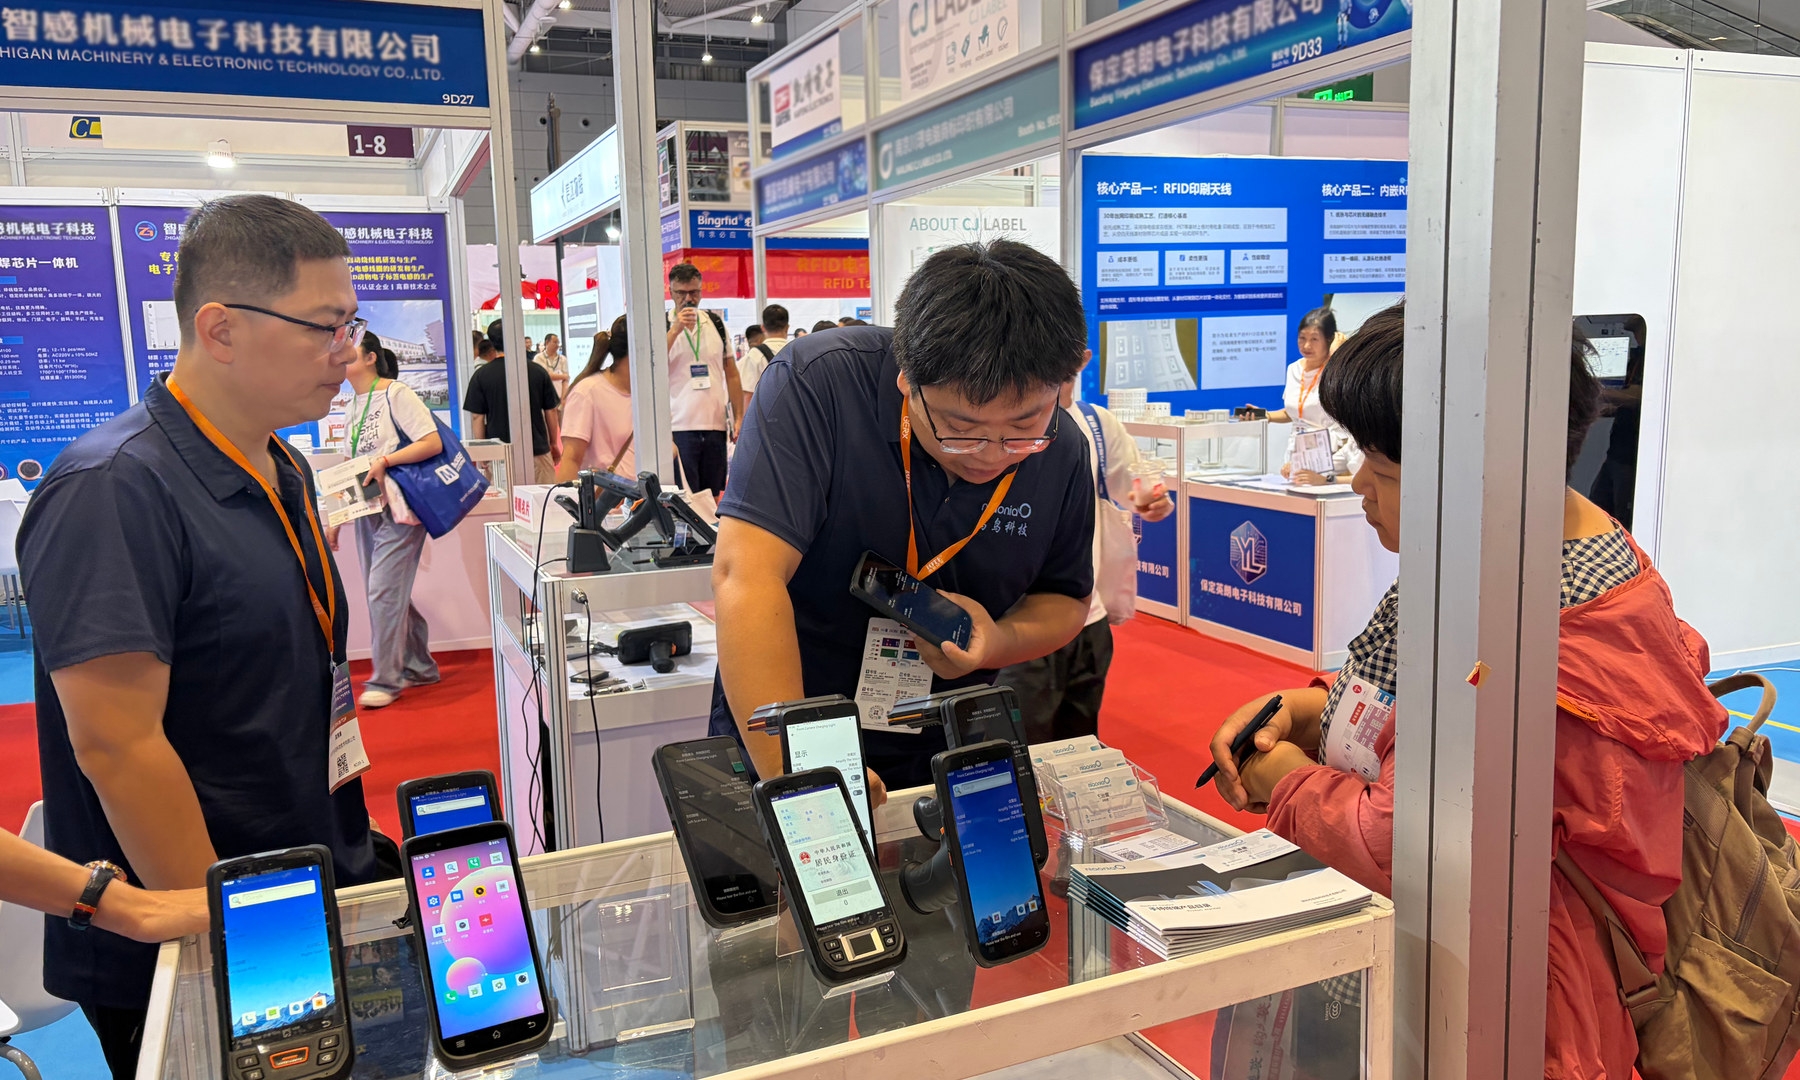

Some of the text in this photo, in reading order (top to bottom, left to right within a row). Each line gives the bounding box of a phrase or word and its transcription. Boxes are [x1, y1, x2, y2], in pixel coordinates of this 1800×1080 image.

[1, 7, 441, 66] 智感机械电子科技有限公司
[1291, 36, 1323, 63] 9D33
[57, 48, 154, 67] MACHINERY
[158, 56, 169, 66] &
[173, 53, 273, 73] ELECTRONIC
[277, 58, 380, 79] TECHNOLOGY
[441, 93, 475, 106] 9D27
[353, 133, 388, 156] 1-8
[1096, 181, 1232, 197] 核心产品一：RFID印刷天线
[909, 217, 1027, 231] ABOUT CJ LABEL
[344, 256, 417, 264] 自动绕线机研发与生产
[823, 277, 855, 289] RFID
[1200, 578, 1303, 618] 保定英朗电子科技有限公司
[794, 749, 808, 758] 显示
[814, 841, 852, 856] 中华人民共和国
[814, 849, 857, 867] 居民身份证
[836, 888, 849, 896] 退出
[250, 1071, 258, 1079] F2
